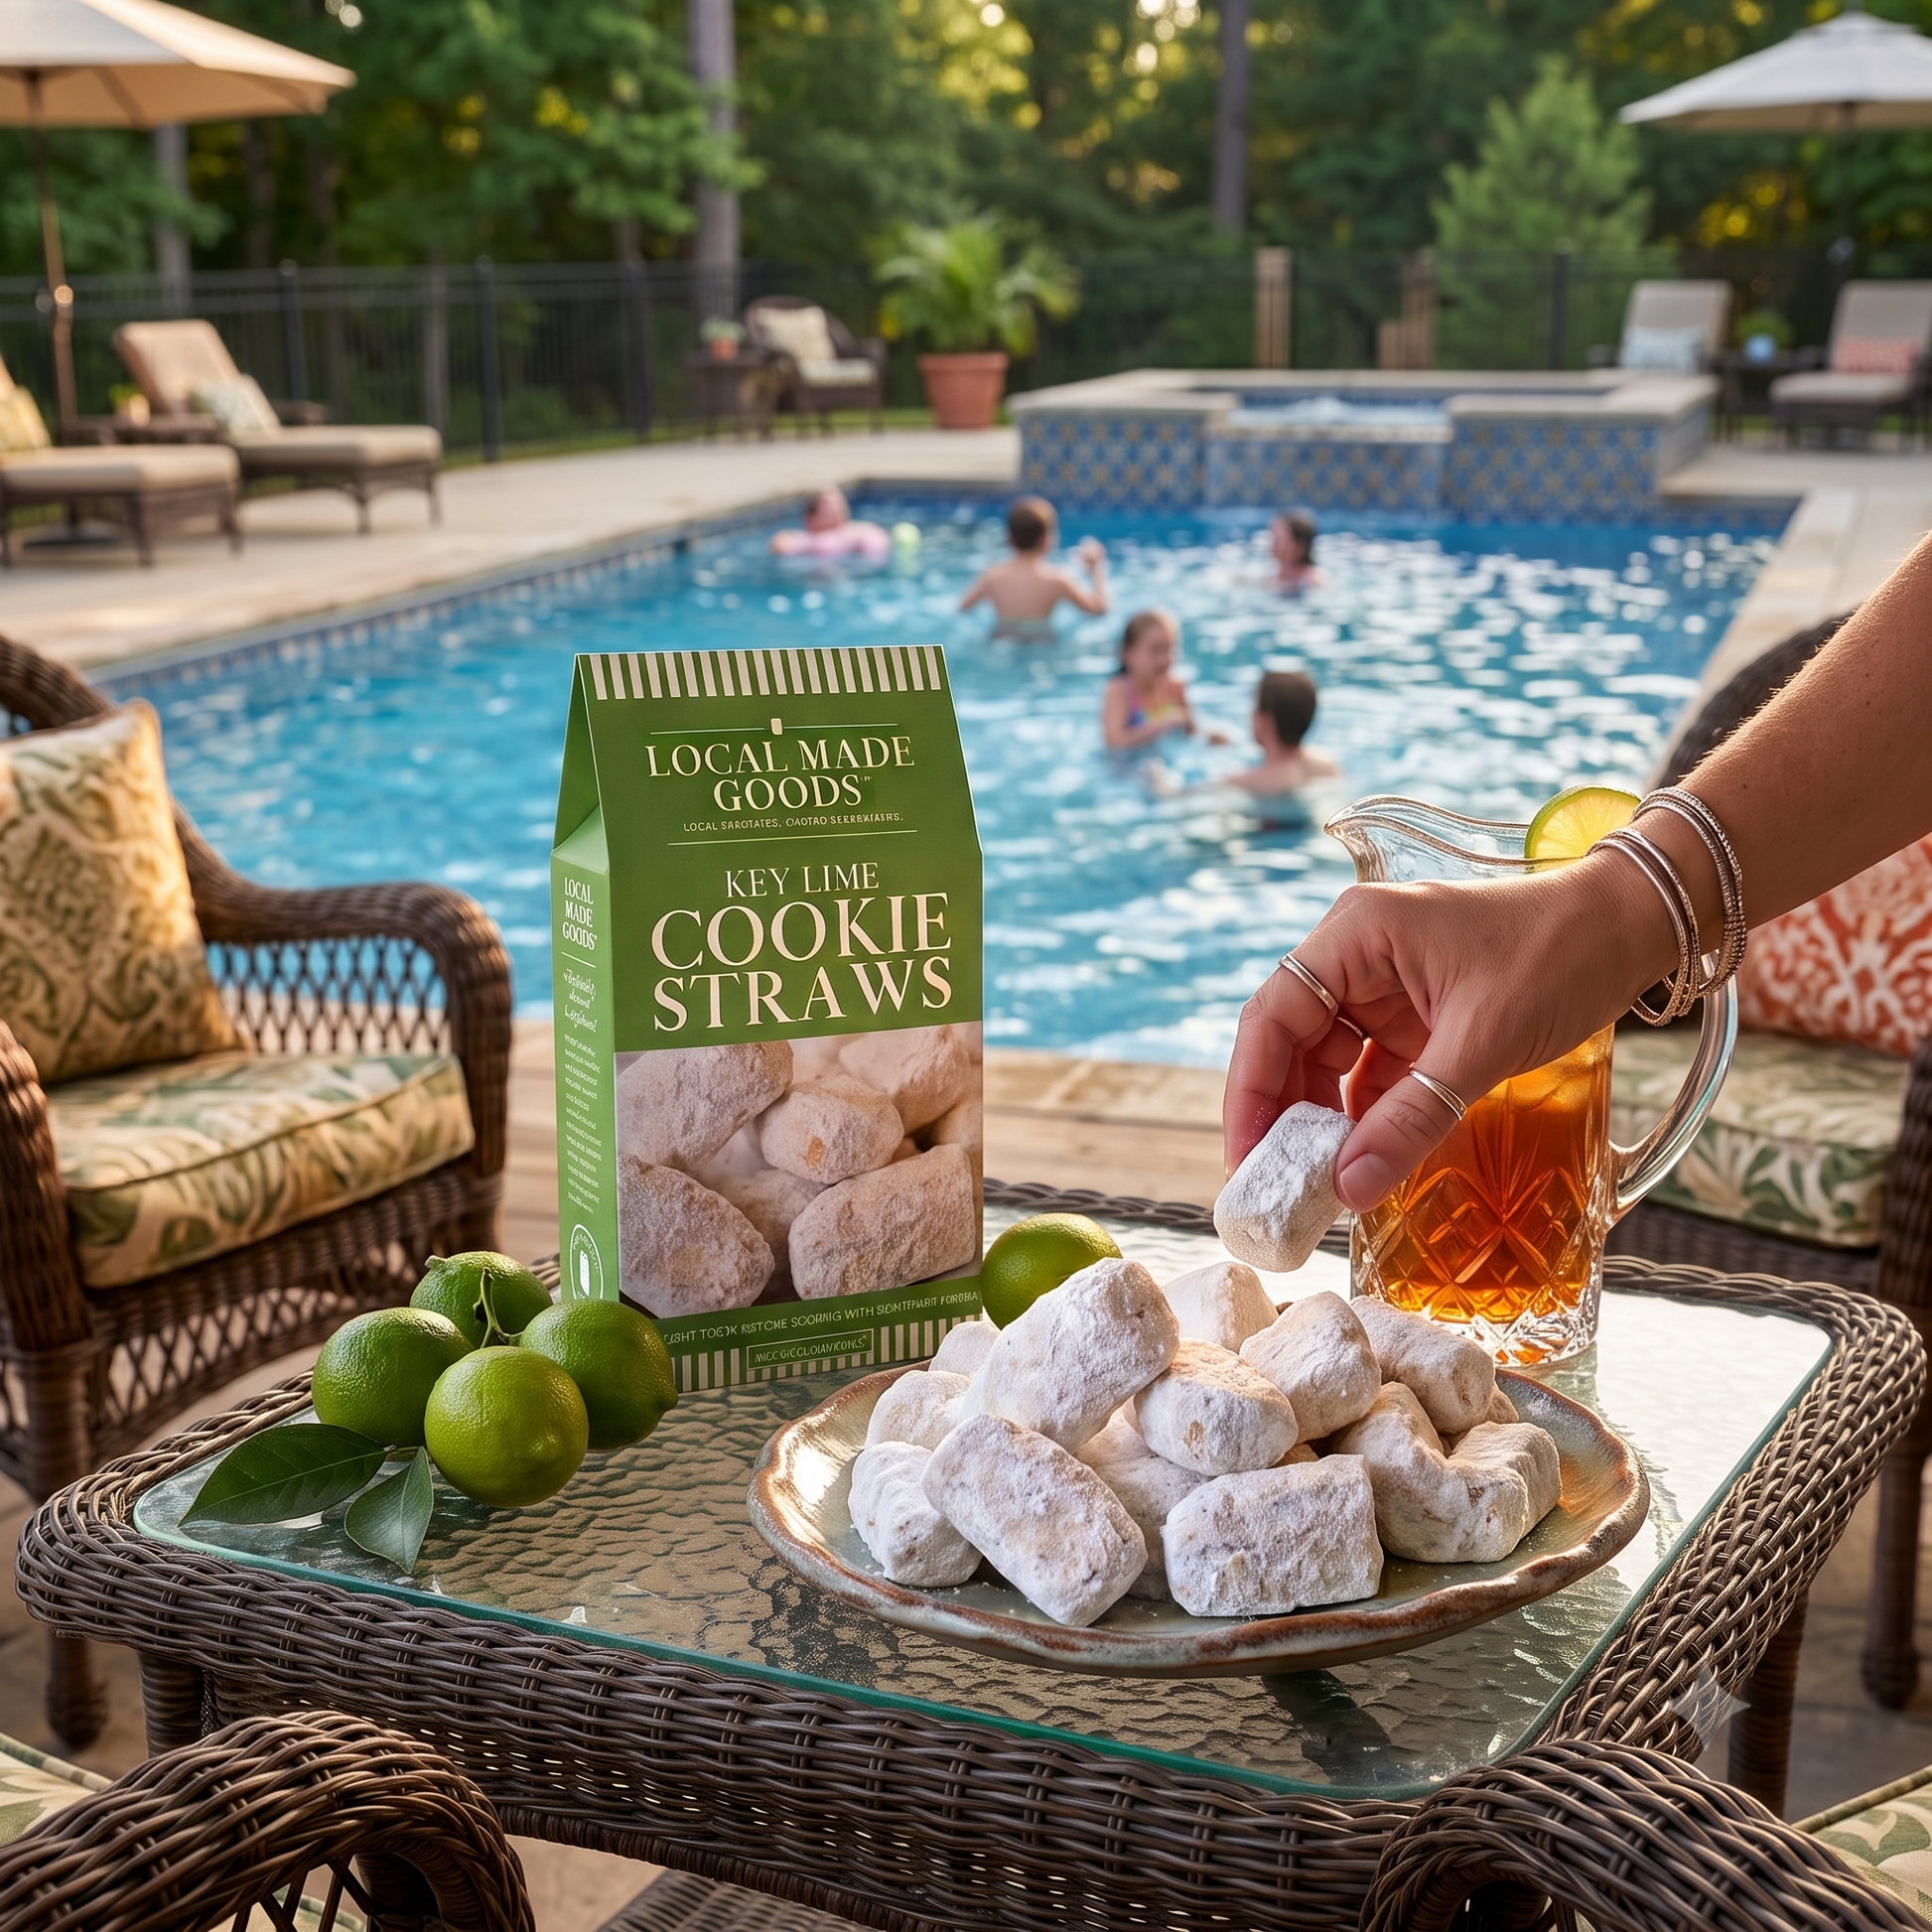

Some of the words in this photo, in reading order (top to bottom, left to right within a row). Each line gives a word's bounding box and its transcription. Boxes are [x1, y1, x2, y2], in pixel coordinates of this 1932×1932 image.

[645, 741, 788, 777] LOCAL
[799, 736, 915, 771] MADE
[683, 822, 719, 832] LOCAL
[564, 877, 594, 905] LOCAL
[725, 868, 790, 898] KEY
[802, 863, 880, 894] LIME
[565, 899, 594, 928] MADE
[650, 893, 952, 970] COOKIE
[652, 956, 953, 1033] STRAWS
[844, 1306, 874, 1320] WITH
